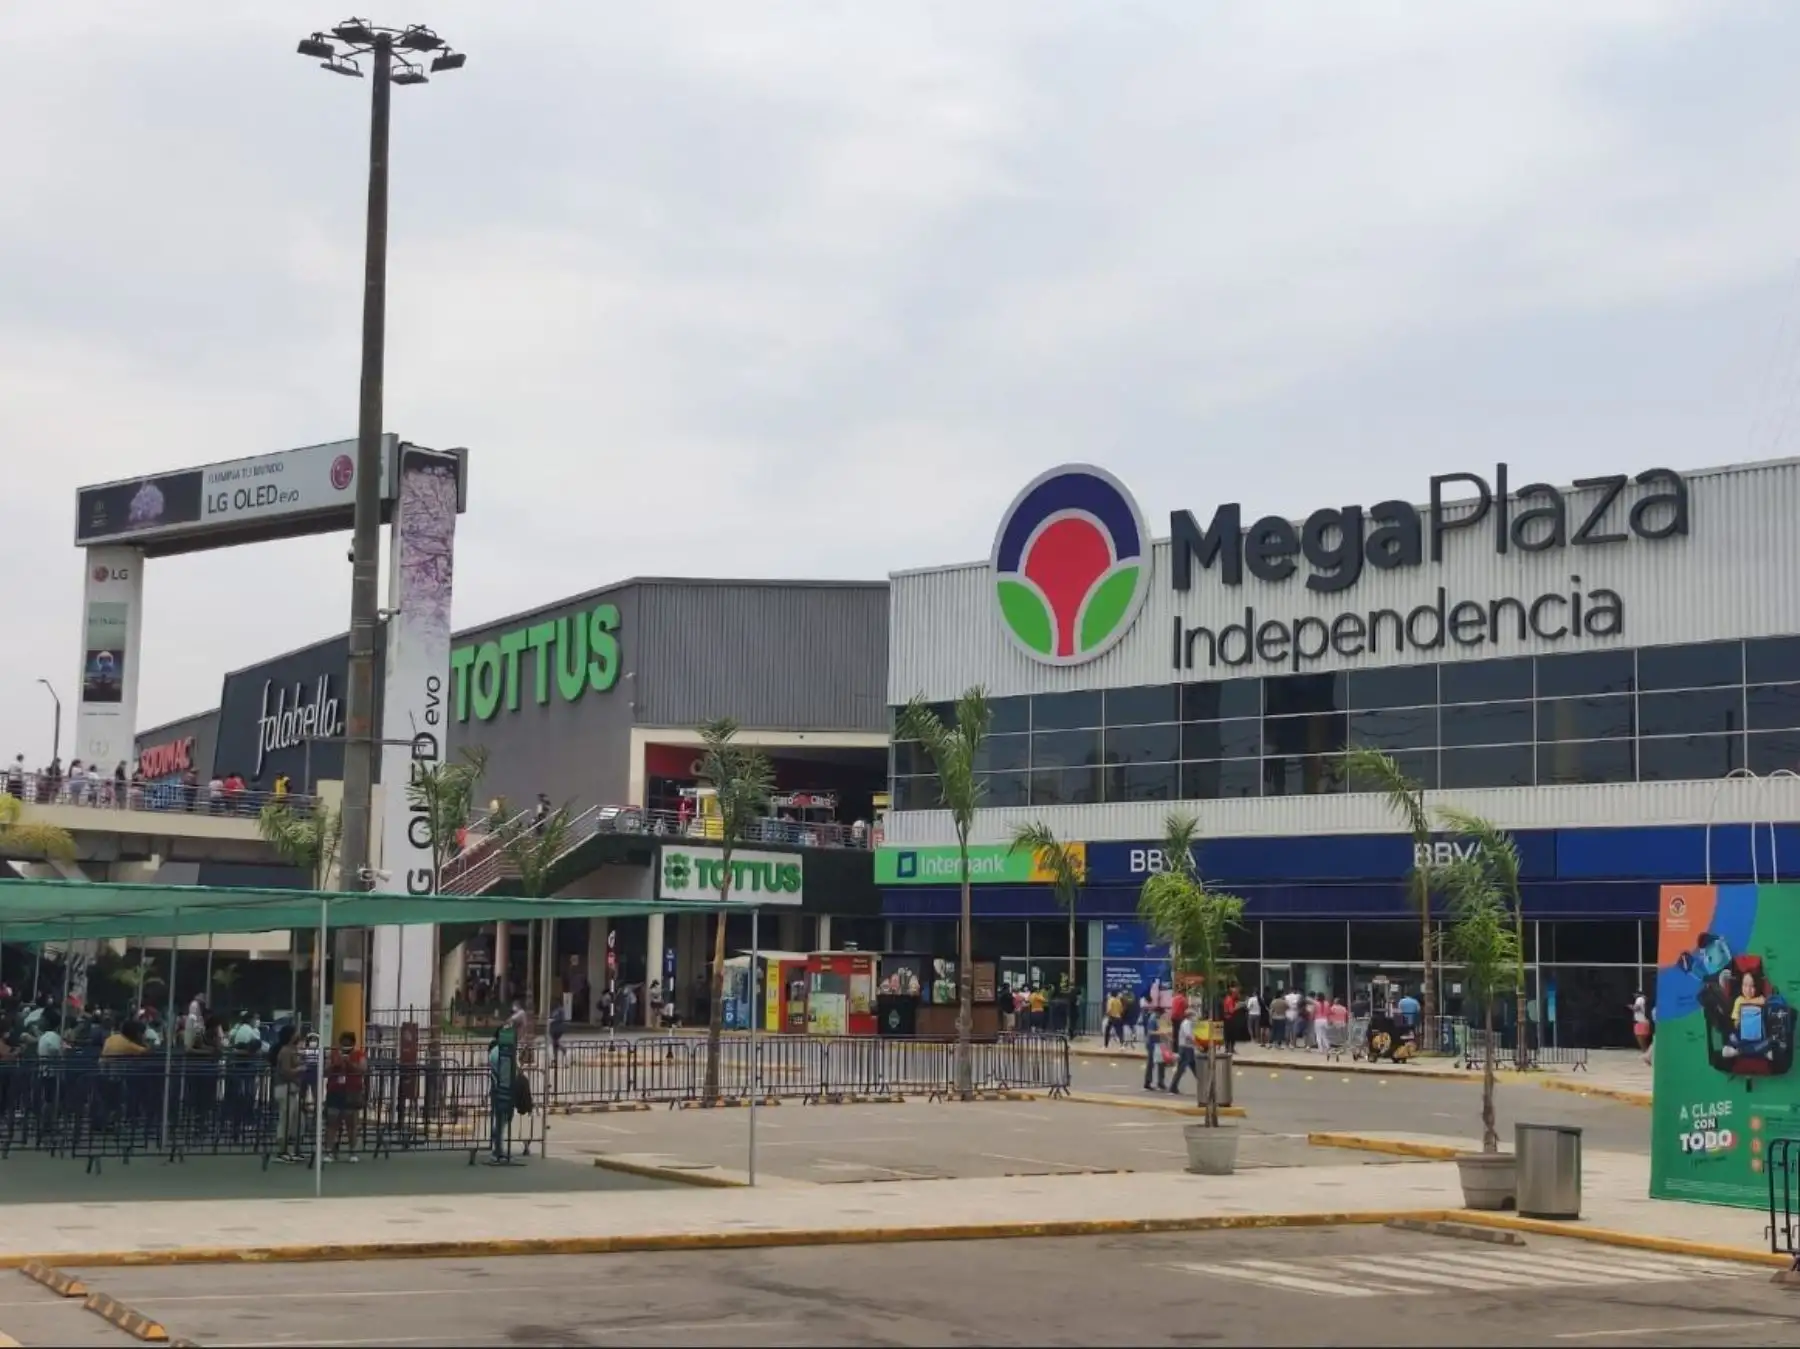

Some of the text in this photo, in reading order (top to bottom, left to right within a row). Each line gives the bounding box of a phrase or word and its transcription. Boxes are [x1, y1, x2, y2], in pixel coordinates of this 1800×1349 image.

[207, 492, 229, 514] LG
[234, 484, 278, 510] OLED
[1170, 463, 1690, 591] MegaPlaza
[111, 568, 129, 581] LG
[1173, 574, 1625, 672] Independencia
[451, 602, 622, 723] TOTTUS
[424, 675, 442, 726] evo
[140, 735, 193, 780] SODIMAC
[1413, 841, 1485, 868] BBV
[694, 858, 801, 893] TOTTUS
[1680, 1105, 1690, 1121] A
[1692, 1100, 1733, 1118] CLASE
[1694, 1118, 1716, 1130] CON
[1679, 1129, 1733, 1153] TODO
